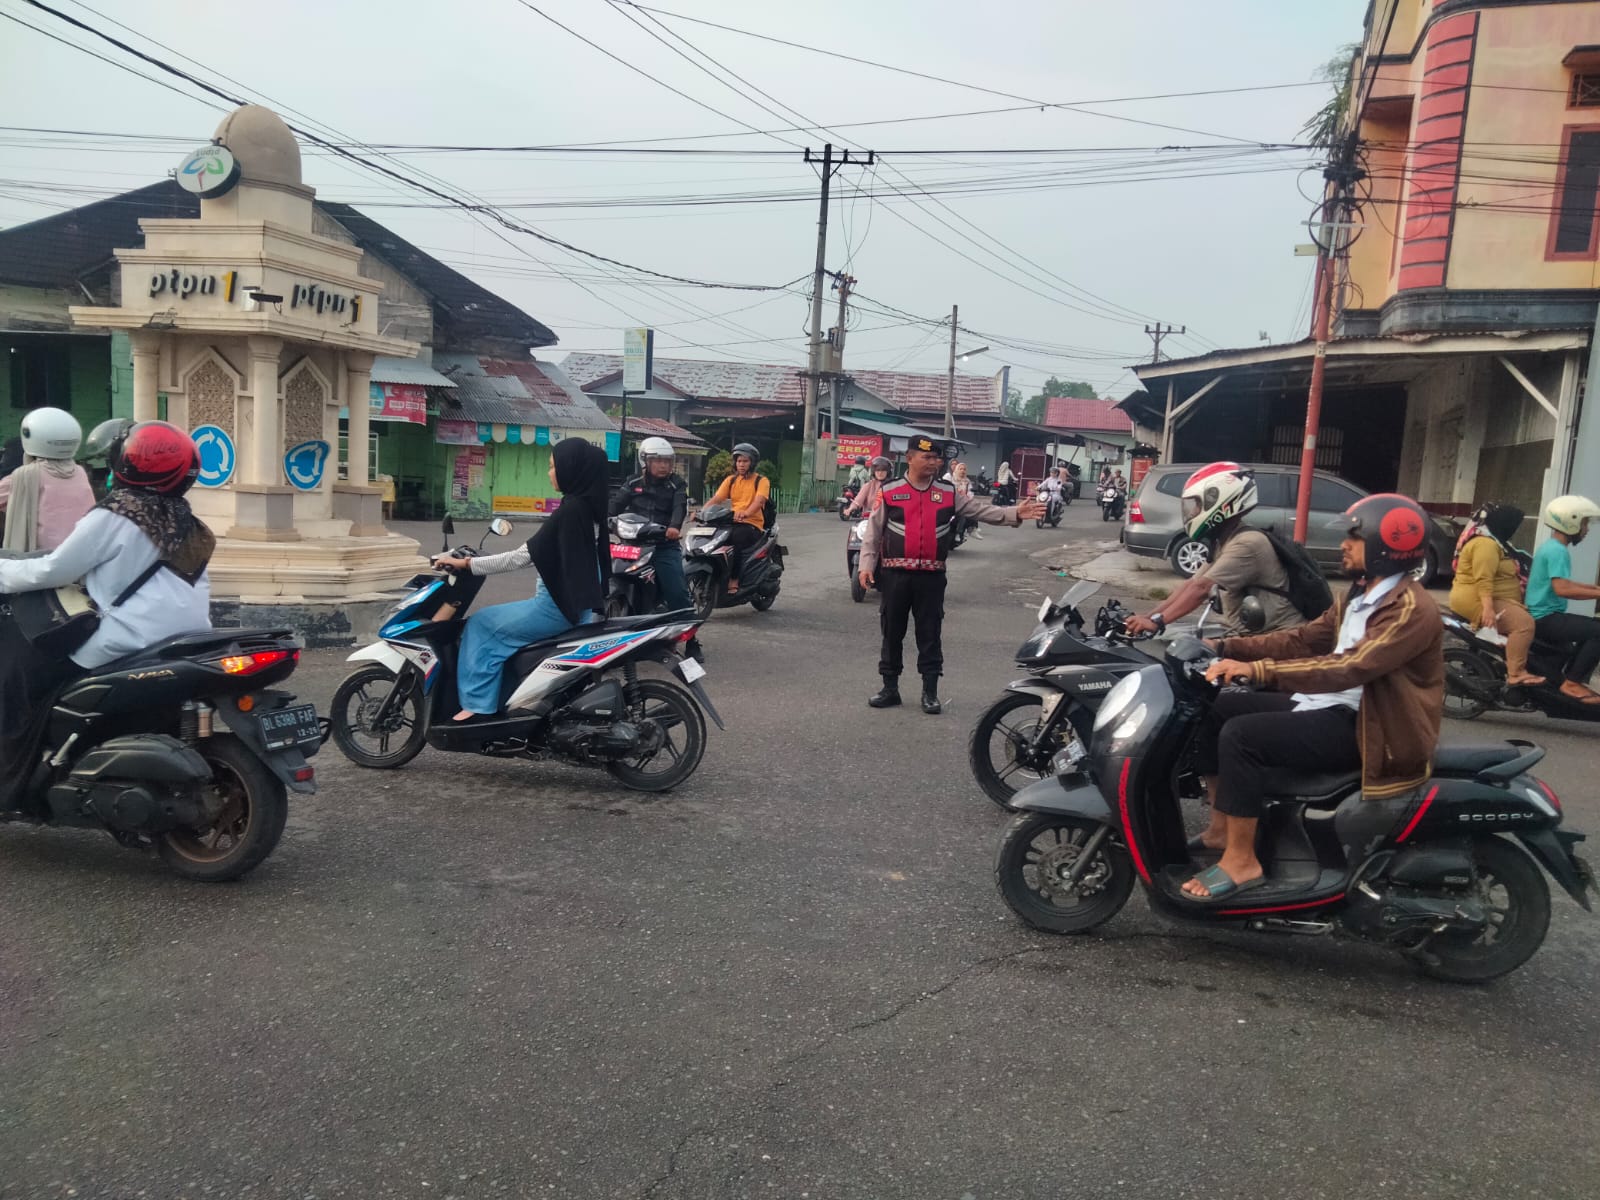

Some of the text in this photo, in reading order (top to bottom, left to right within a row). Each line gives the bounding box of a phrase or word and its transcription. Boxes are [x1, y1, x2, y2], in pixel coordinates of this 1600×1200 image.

[837, 446, 871, 454] ERBA
[1078, 681, 1113, 691] YAMAHA
[1459, 812, 1534, 821] SCOOPY
